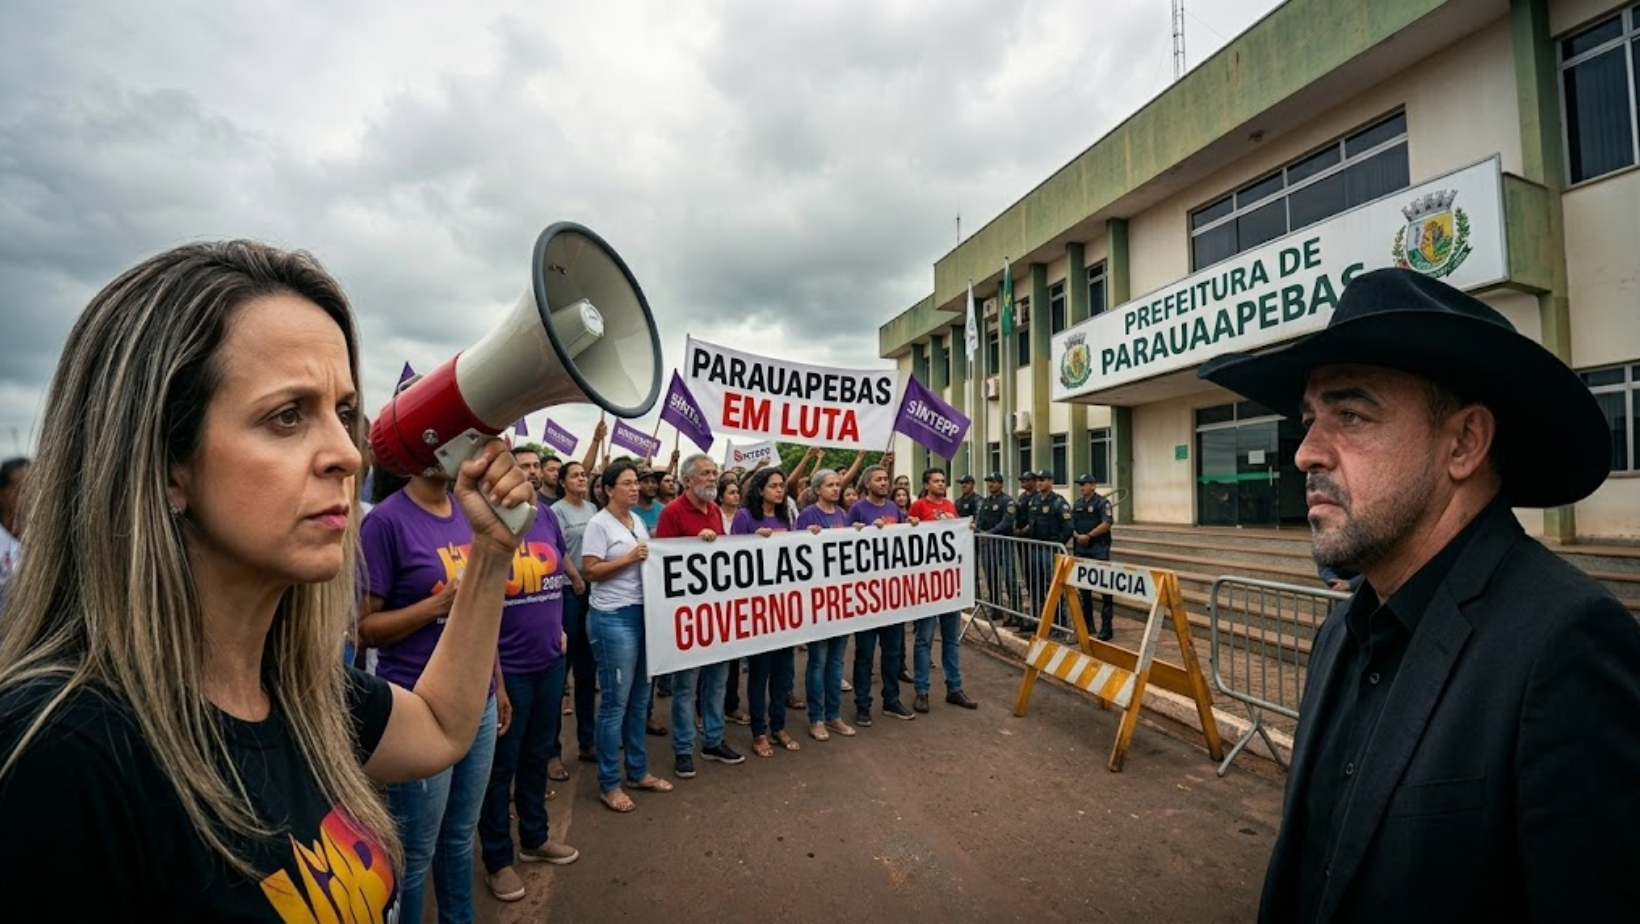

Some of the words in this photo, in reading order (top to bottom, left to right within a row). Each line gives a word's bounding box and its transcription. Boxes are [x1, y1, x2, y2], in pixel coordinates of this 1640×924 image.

[1124, 257, 1269, 335] PREFEITURA
[1279, 236, 1322, 279] DE
[691, 347, 892, 406] PARAUAPEBAS
[722, 391, 771, 433] EM
[780, 401, 860, 443] LUTA
[663, 544, 812, 599] ESCOLAS
[822, 530, 962, 578] FECHADAS,
[1077, 565, 1147, 597] POLICIA
[674, 590, 804, 651] GOVERNO
[811, 567, 961, 625] PRESSIONADO!
